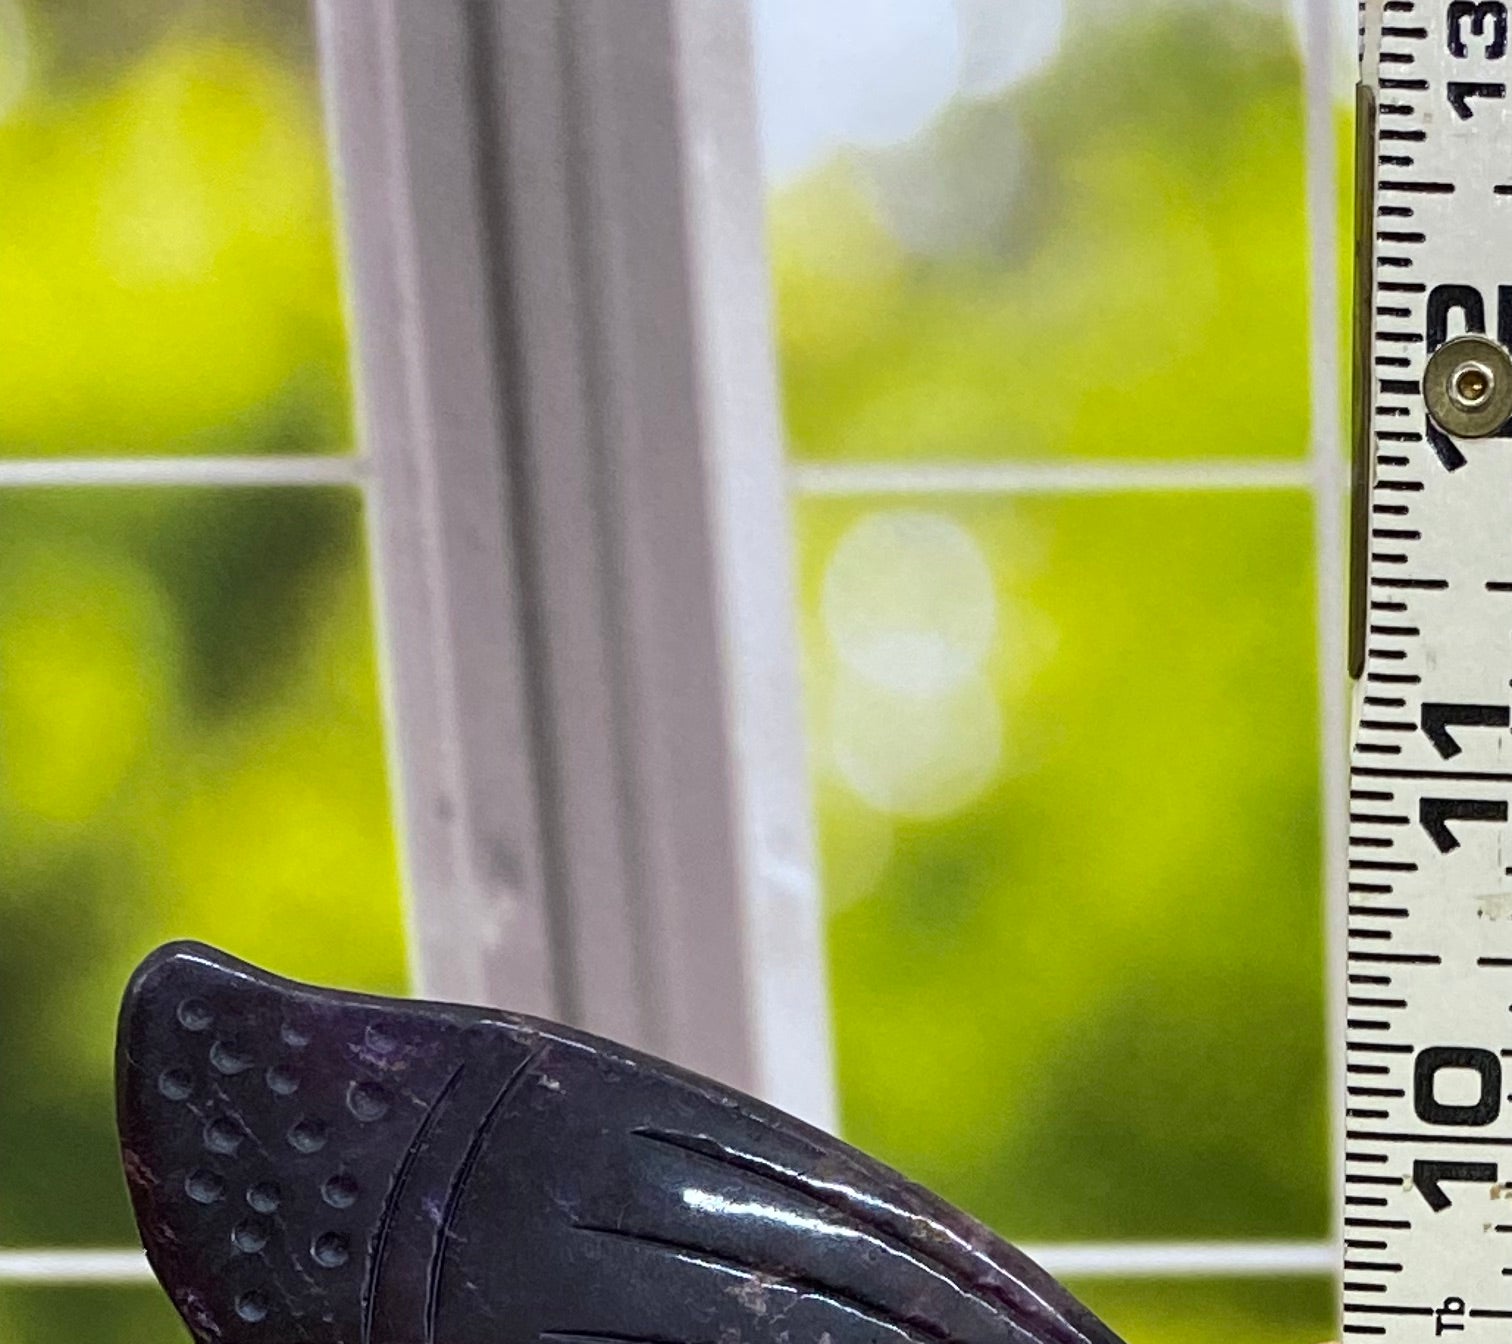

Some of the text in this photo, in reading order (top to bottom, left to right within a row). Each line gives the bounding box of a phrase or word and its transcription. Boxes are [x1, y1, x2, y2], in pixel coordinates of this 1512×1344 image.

[1446, 2, 1507, 120] 13
[1419, 702, 1511, 855] 11
[1412, 1046, 1502, 1213] 10
[1434, 1296, 1466, 1336] Tb
